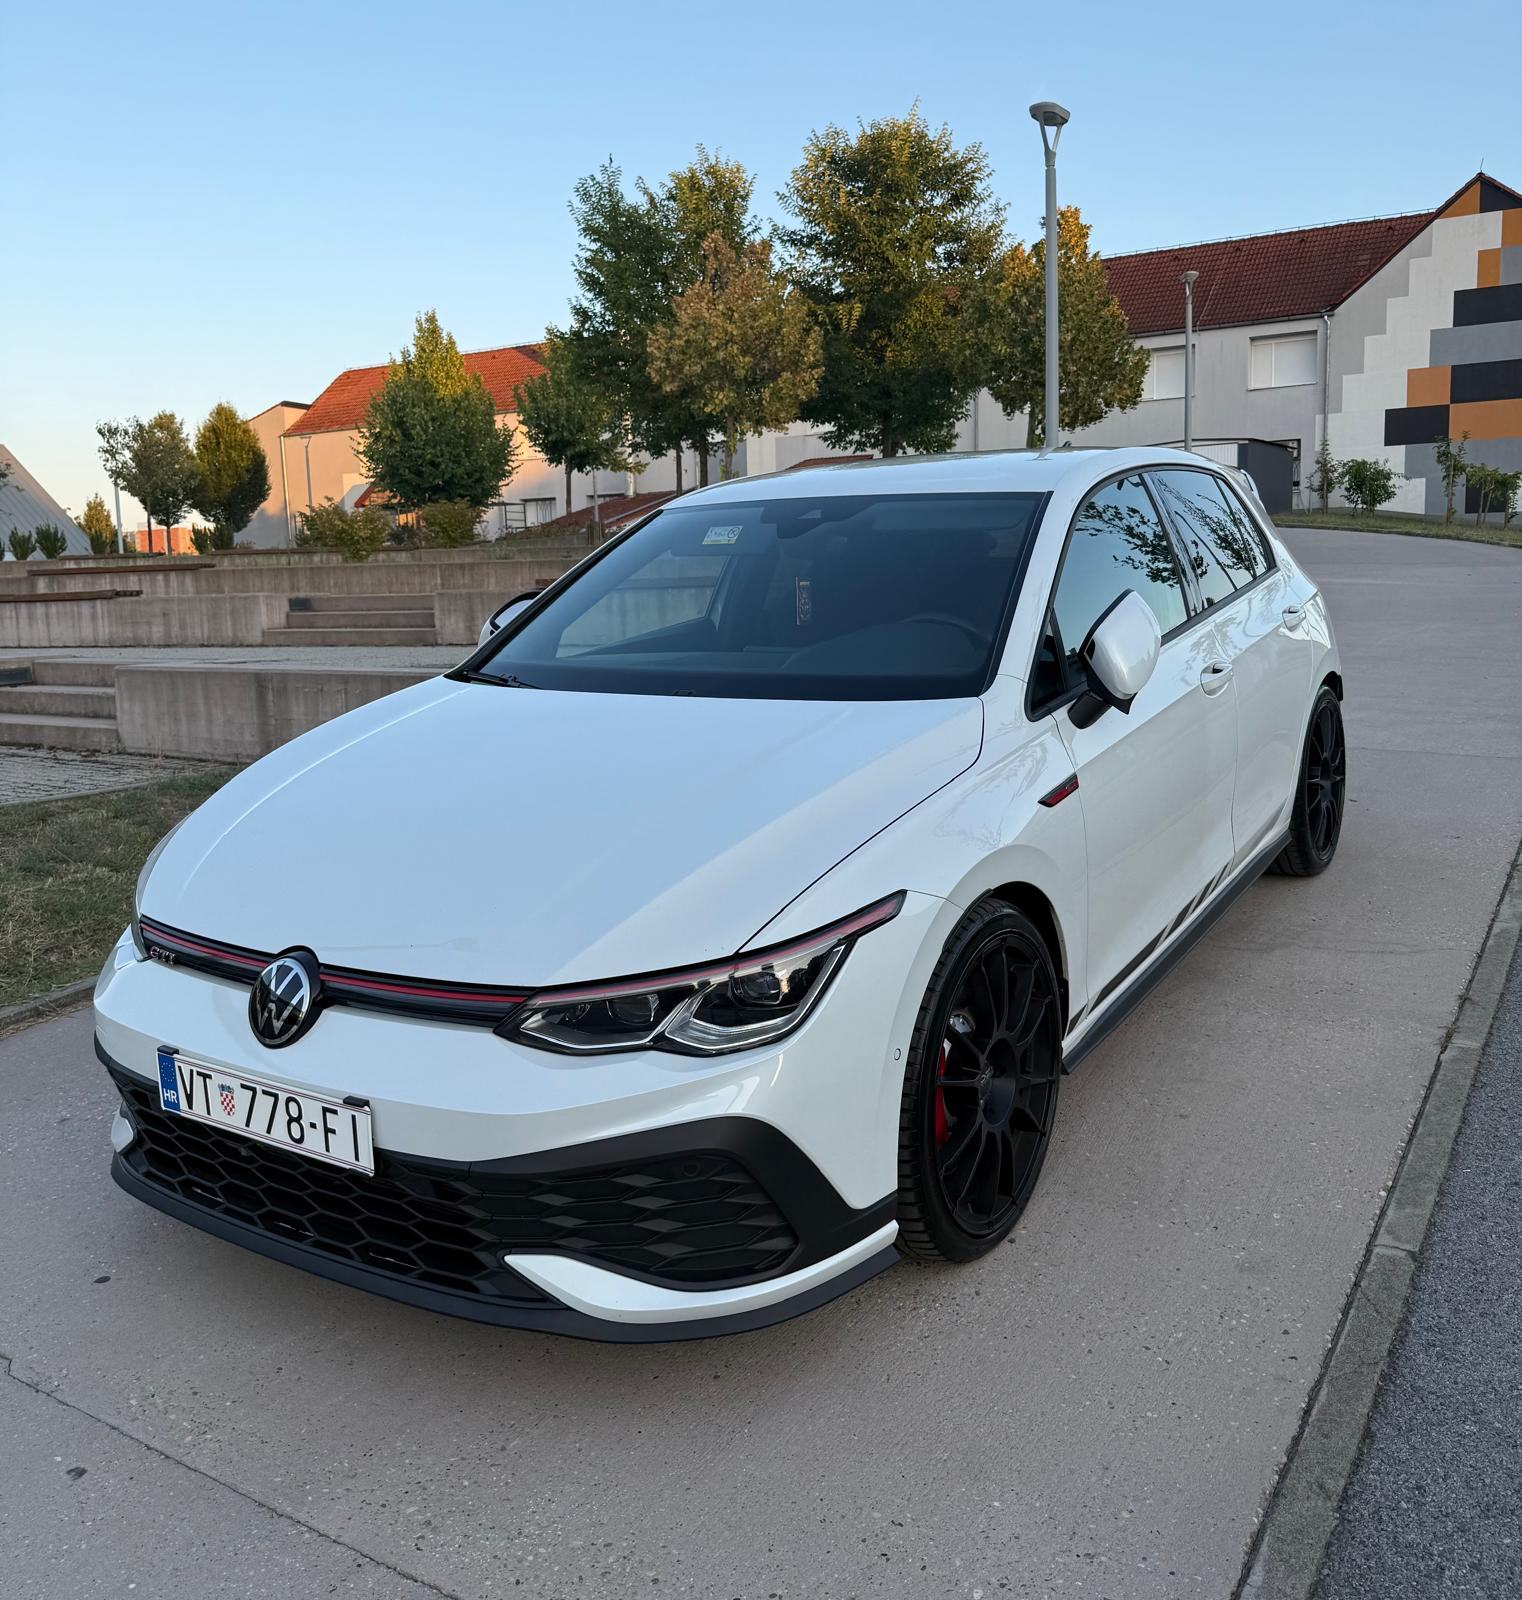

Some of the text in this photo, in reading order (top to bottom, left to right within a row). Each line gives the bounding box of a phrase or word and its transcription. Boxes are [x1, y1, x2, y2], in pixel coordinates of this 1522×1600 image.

[149, 946, 176, 966] GTI
[163, 1088, 178, 1104] HR
[178, 1065, 360, 1163] VT 778-FI
